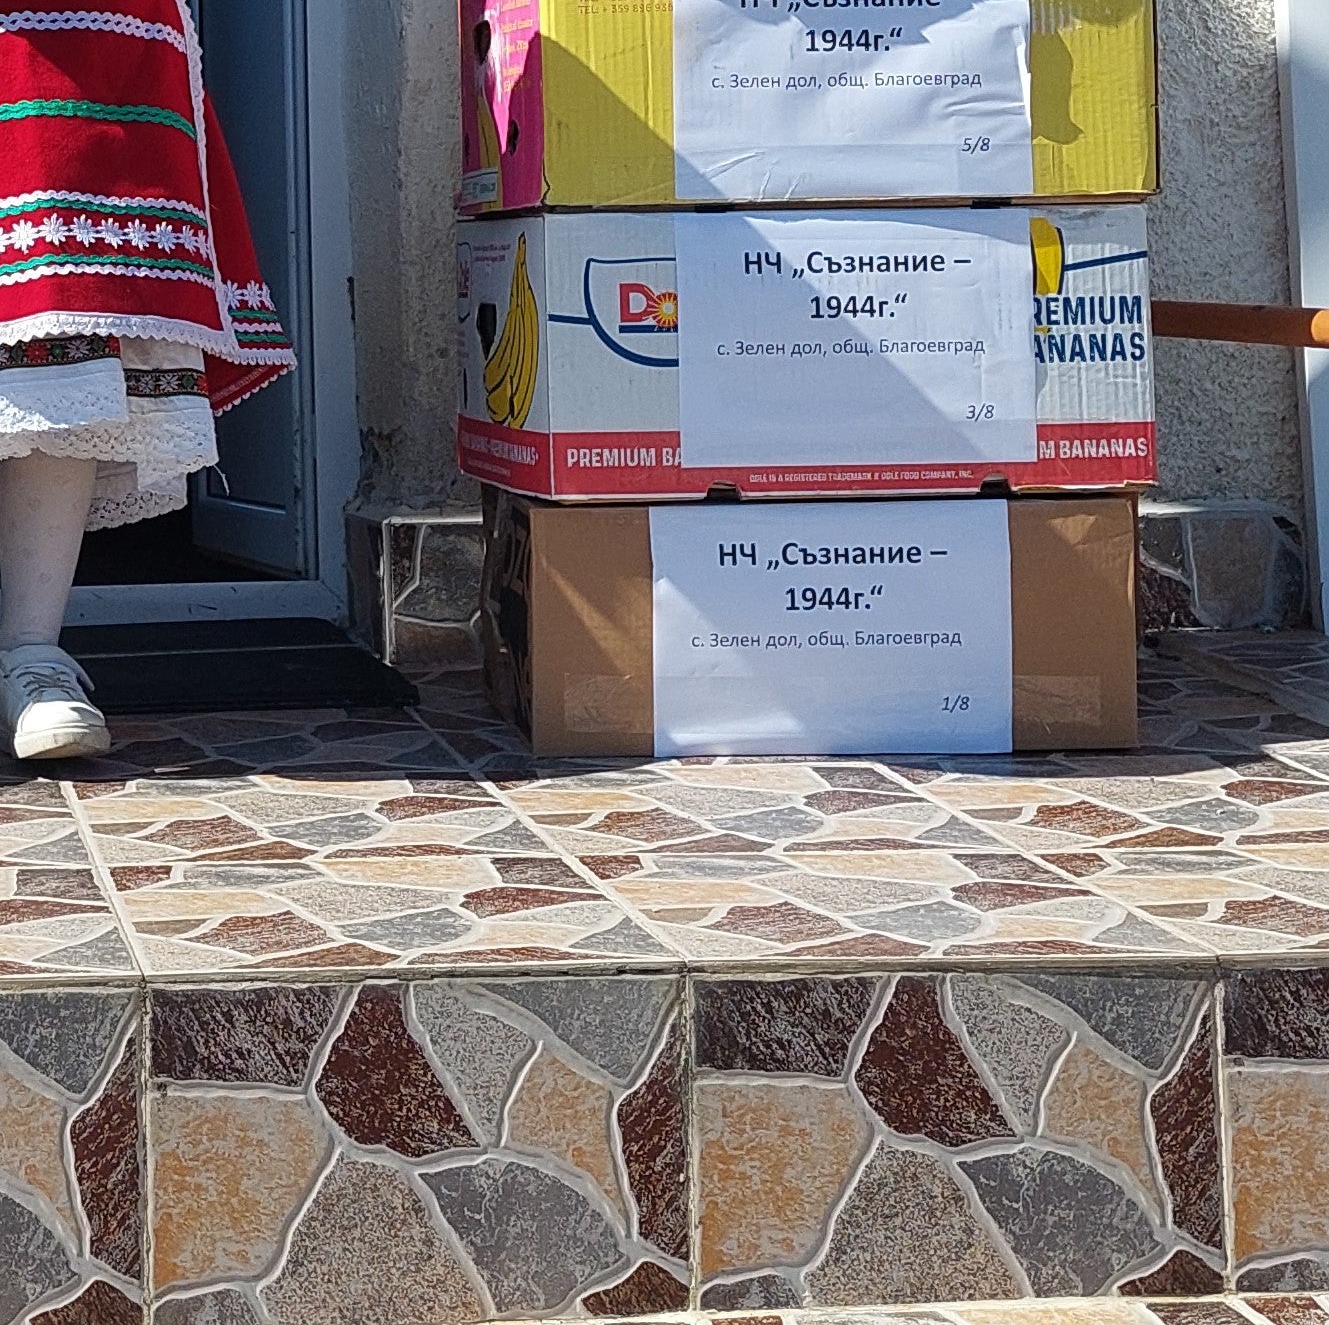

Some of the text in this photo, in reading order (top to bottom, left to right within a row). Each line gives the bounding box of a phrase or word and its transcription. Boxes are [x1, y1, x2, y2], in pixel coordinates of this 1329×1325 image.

[711, 71, 982, 91] с. Зелен дол, общ. Благоевград
[961, 135, 991, 155] 5/8
[744, 251, 782, 275] НЧ
[1033, 295, 1143, 326] REMIUM
[717, 338, 986, 359] с. Зелен дол, общ. Благоевград
[1034, 332, 1146, 364] ANANAS
[965, 402, 995, 423] 3/8
[566, 447, 656, 468] PREMIUM
[1059, 437, 1148, 459] BANANAS
[784, 473, 827, 483] REGISTERED
[828, 472, 872, 482] TRADEMARK
[718, 542, 757, 567] НЧ
[691, 630, 963, 650] с. Зелен дол, общ. Благоевград
[941, 694, 971, 714] 1/8
